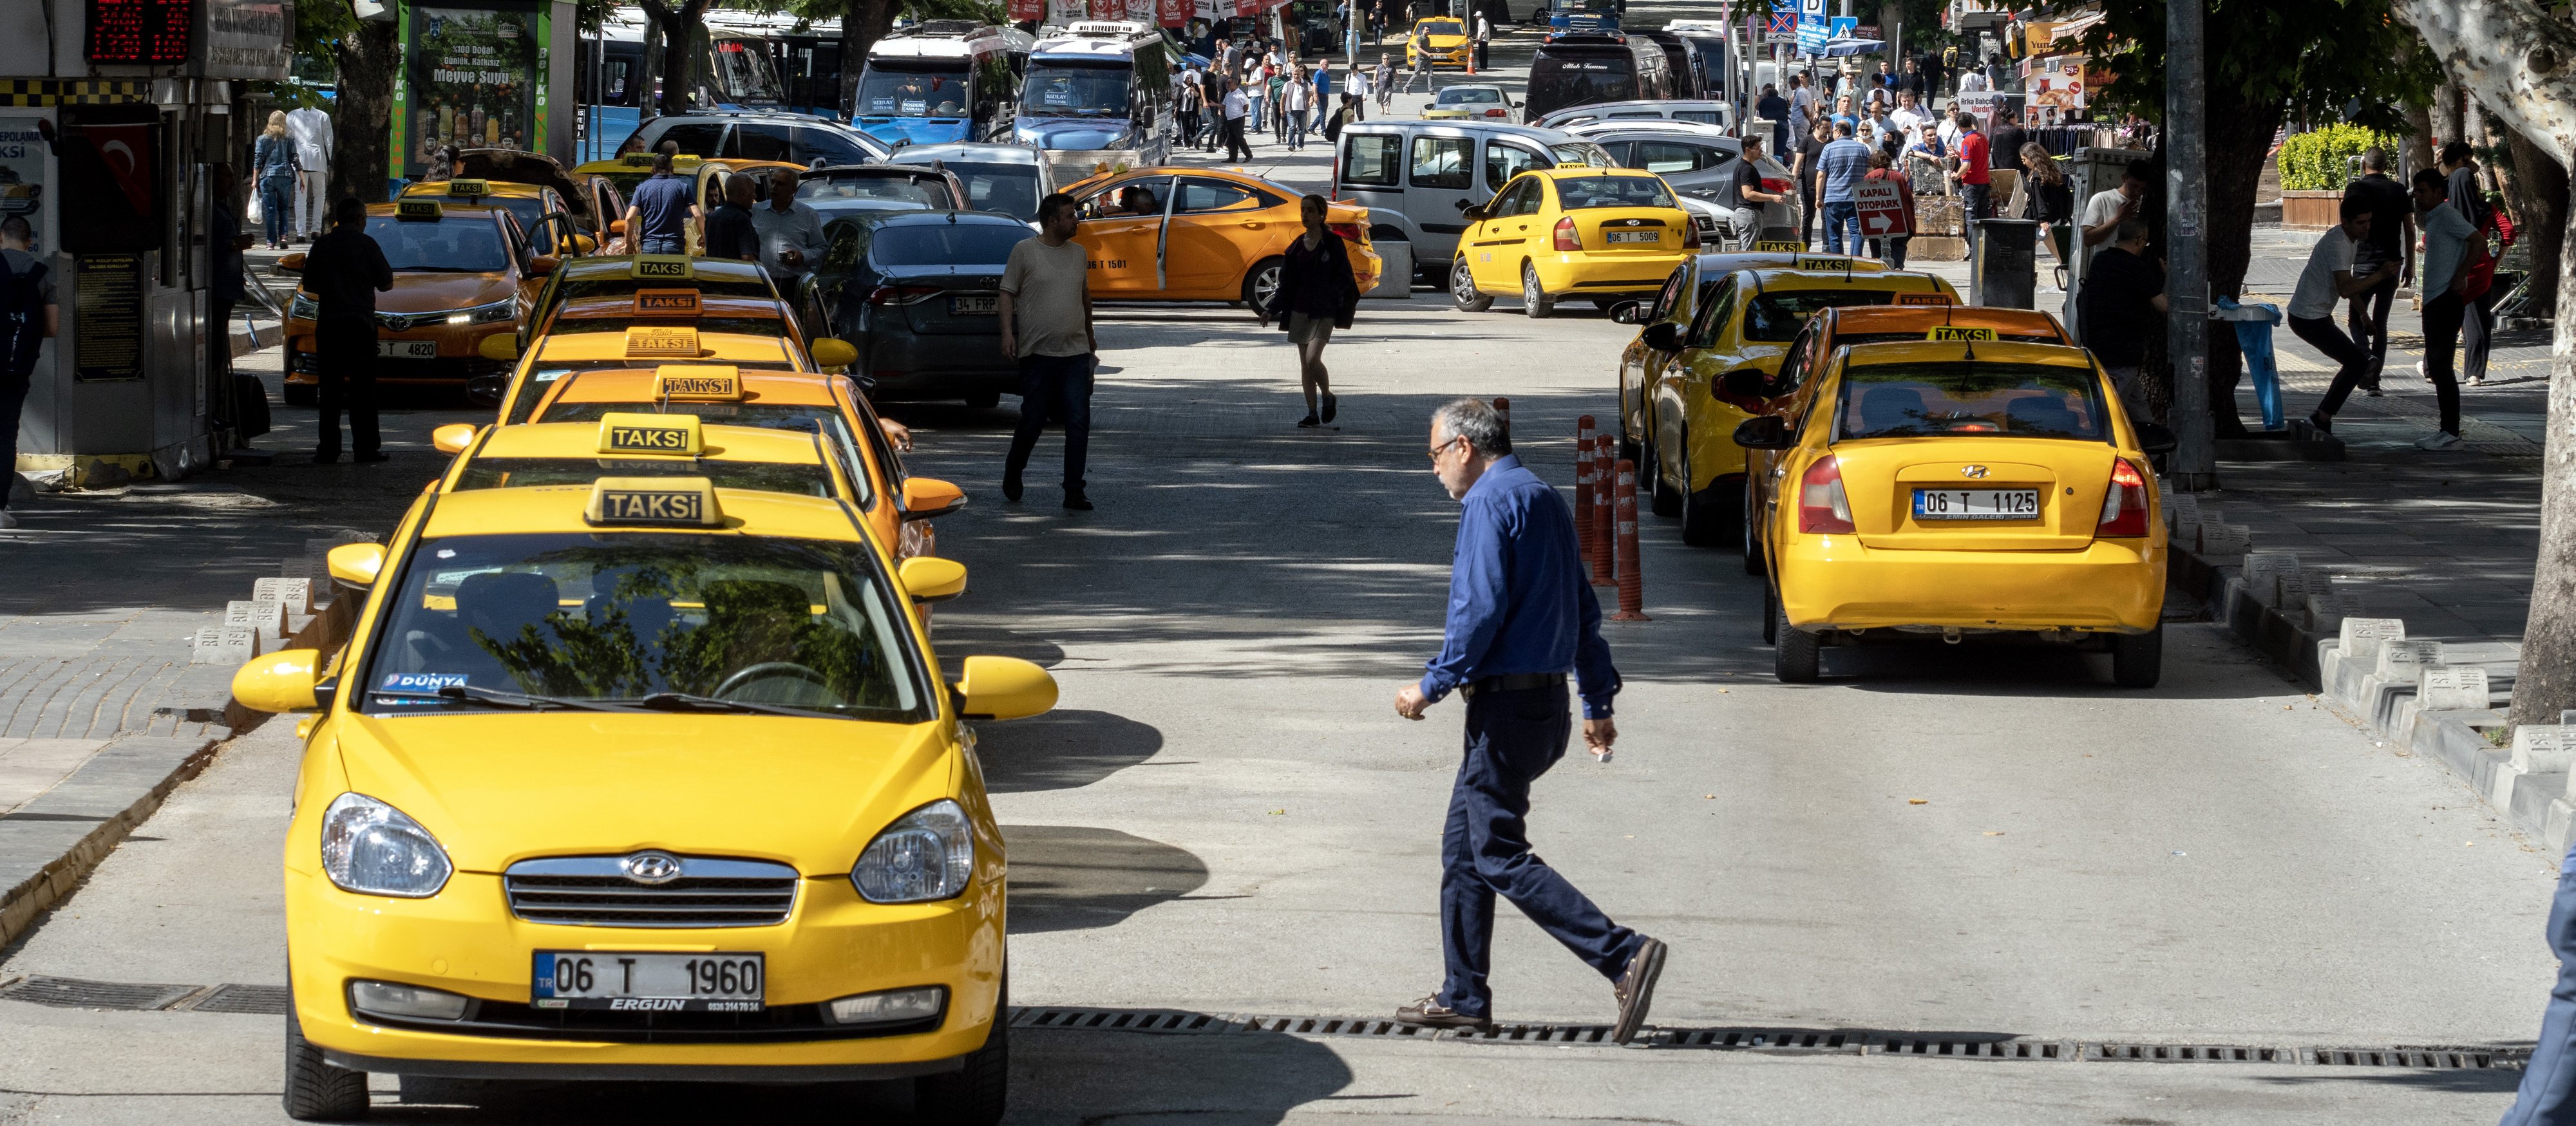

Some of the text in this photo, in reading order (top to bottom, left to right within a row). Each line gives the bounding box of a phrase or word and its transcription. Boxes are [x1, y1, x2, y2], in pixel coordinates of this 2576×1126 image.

[472, 45, 494, 55] Doğal
[472, 58, 500, 67] Katkısız
[434, 69, 509, 85] Meyve Suyu
[1859, 187, 1892, 198] KAPALI
[1857, 199, 1900, 210] OTOPARK
[1612, 232, 1658, 241] 06 T 5009
[1099, 260, 1104, 269] T
[1108, 259, 1126, 268] 1501
[956, 298, 996, 310] 34 FRP
[388, 343, 395, 352] T
[408, 344, 434, 355] 4820
[1927, 493, 2035, 512] 06 T 1125
[400, 675, 466, 687] DÜNYA
[556, 957, 757, 995] 06 T 1960
[538, 977, 553, 988] TR
[610, 999, 686, 1011] ERGUN
[725, 1002, 739, 1011] 314
[740, 1003, 749, 1011] 70
[750, 1003, 759, 1011] 34
